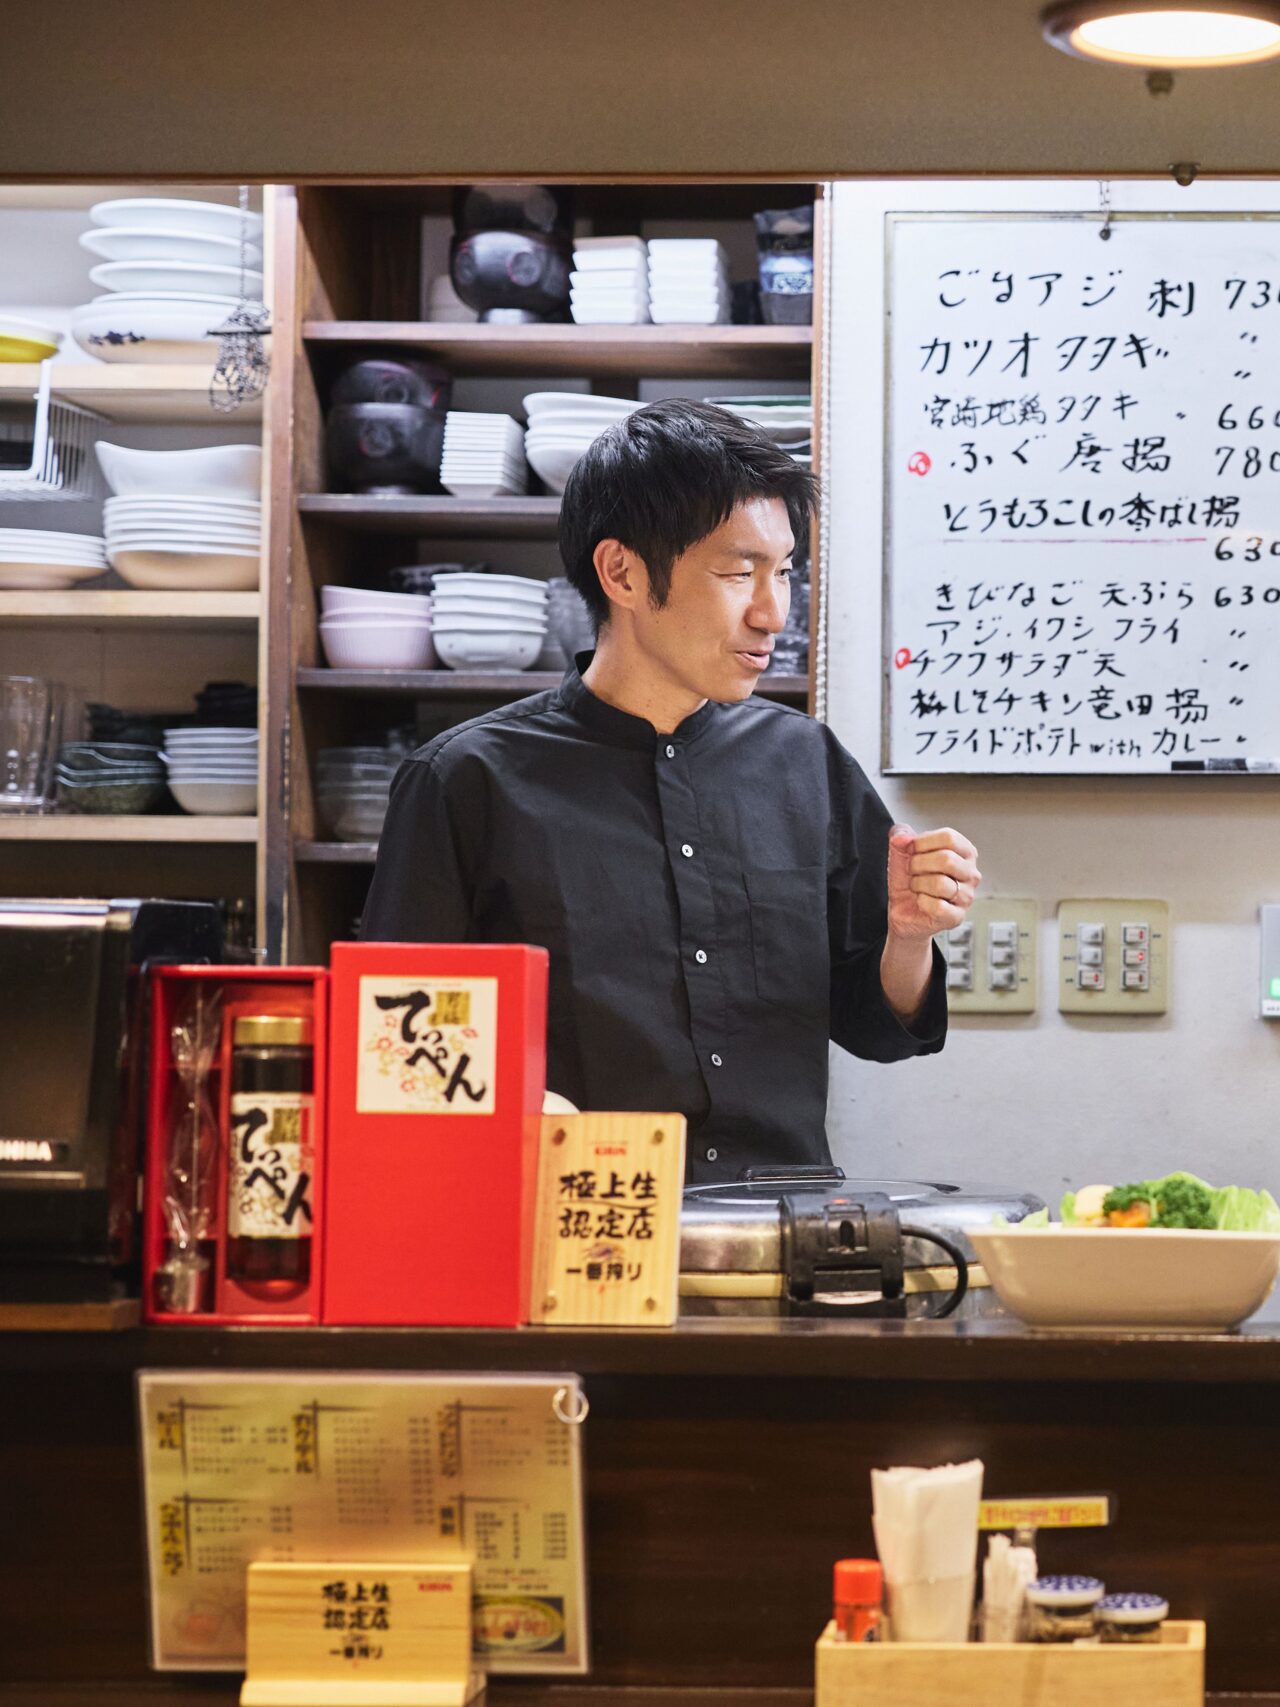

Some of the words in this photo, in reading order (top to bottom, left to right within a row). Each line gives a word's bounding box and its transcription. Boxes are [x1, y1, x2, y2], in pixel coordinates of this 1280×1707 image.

[1215, 586, 1280, 607] 630
[374, 990, 488, 1102] てっぺん
[559, 1171, 658, 1200] 極上生
[558, 1206, 655, 1240] 認定店
[566, 1262, 642, 1281] 一番搾り
